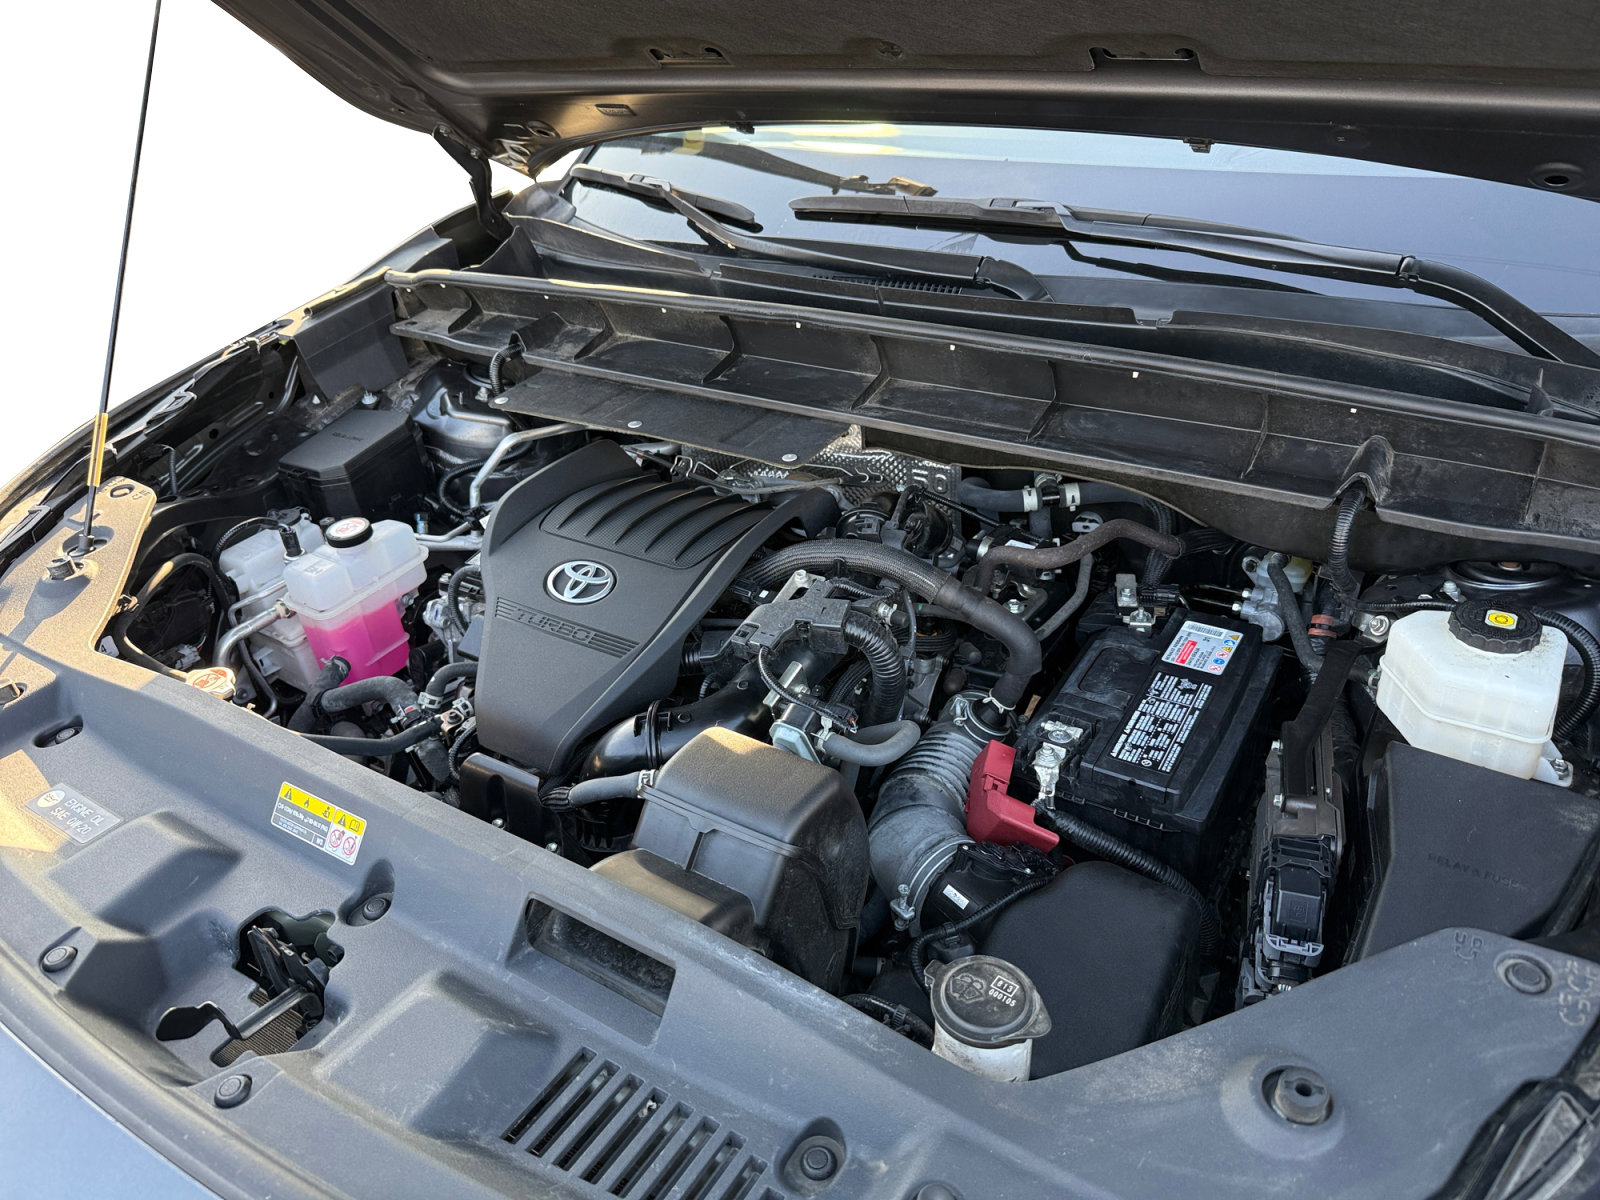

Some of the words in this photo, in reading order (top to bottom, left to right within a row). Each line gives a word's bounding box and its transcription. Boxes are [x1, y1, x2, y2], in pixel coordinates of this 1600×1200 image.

[515, 607, 591, 642] TURBO
[50, 807, 71, 820] SAE
[64, 798, 94, 818] ENGINE
[989, 989, 1017, 1006] 000105
